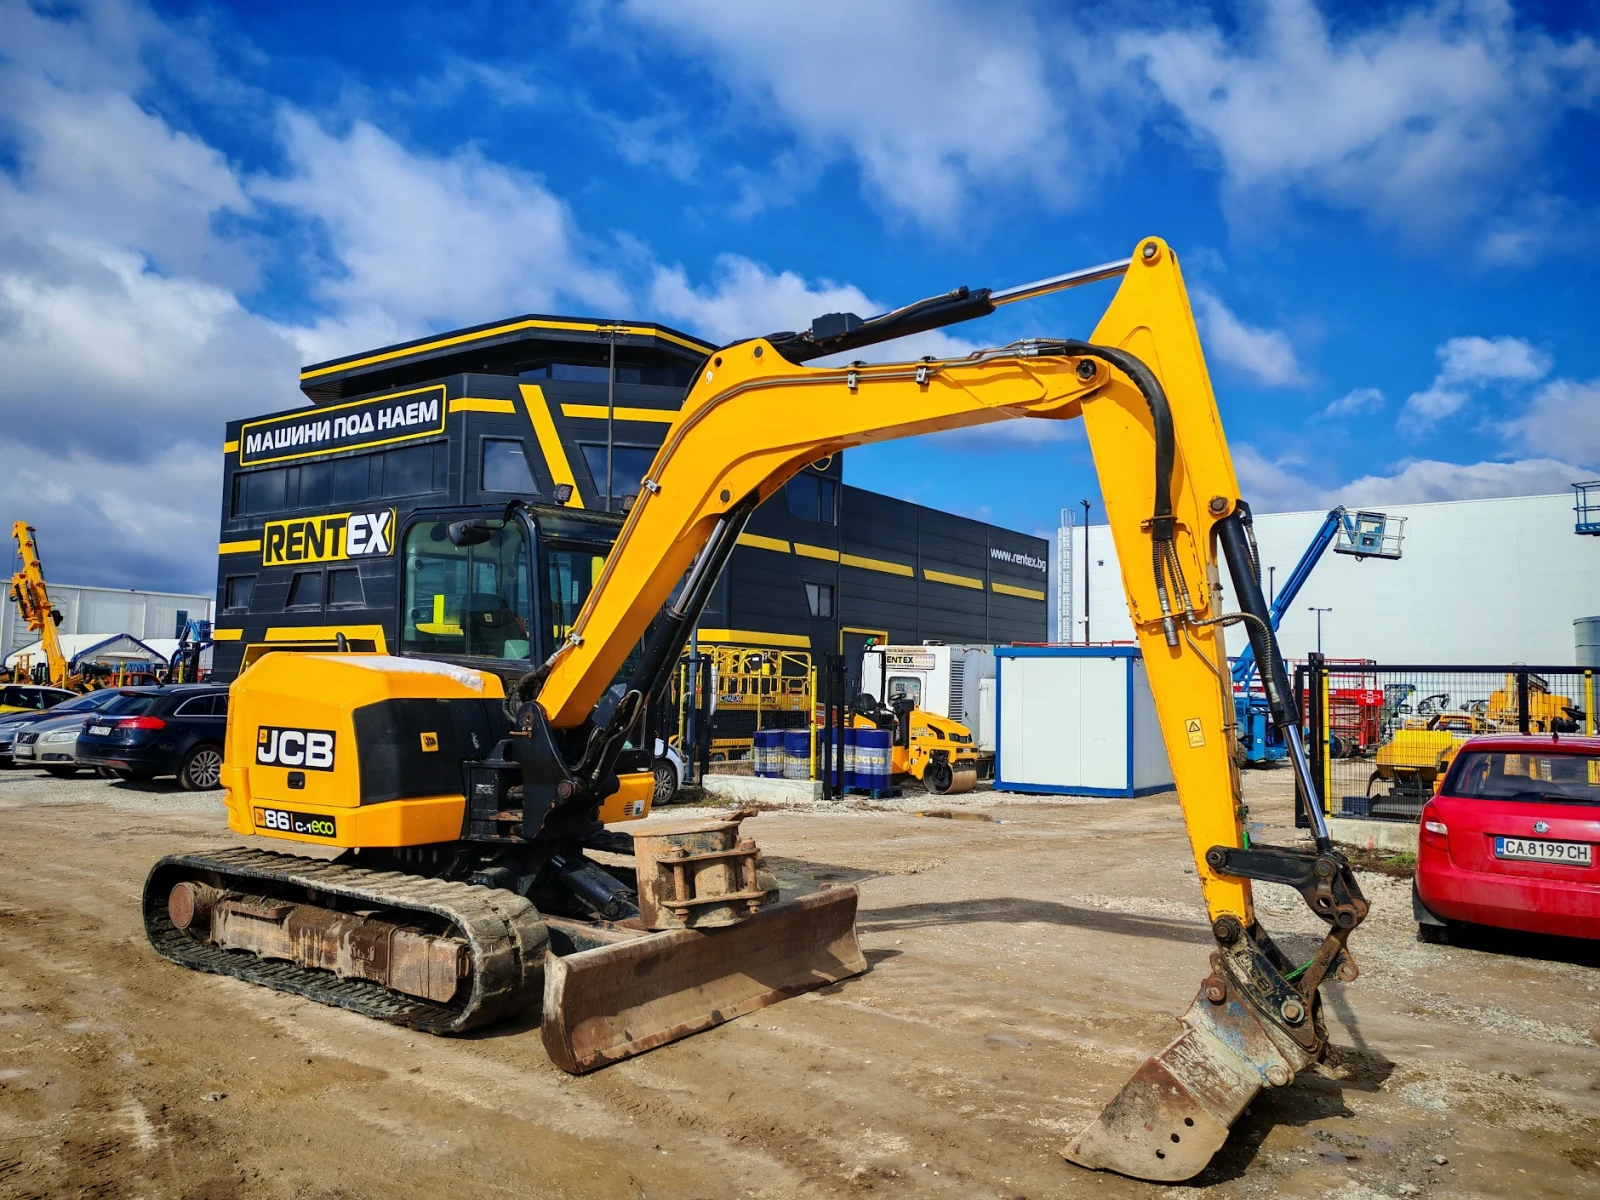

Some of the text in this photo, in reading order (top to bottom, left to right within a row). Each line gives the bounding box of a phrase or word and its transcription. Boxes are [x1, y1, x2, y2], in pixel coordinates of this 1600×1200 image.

[246, 399, 438, 454] МАШИНИ ПОД НАЕМ
[265, 511, 390, 562] RENTEX
[990, 547, 1046, 572] www.rentex.bg
[886, 655, 914, 664] ENTEX
[257, 730, 334, 768] JCB
[265, 809, 290, 830] 86
